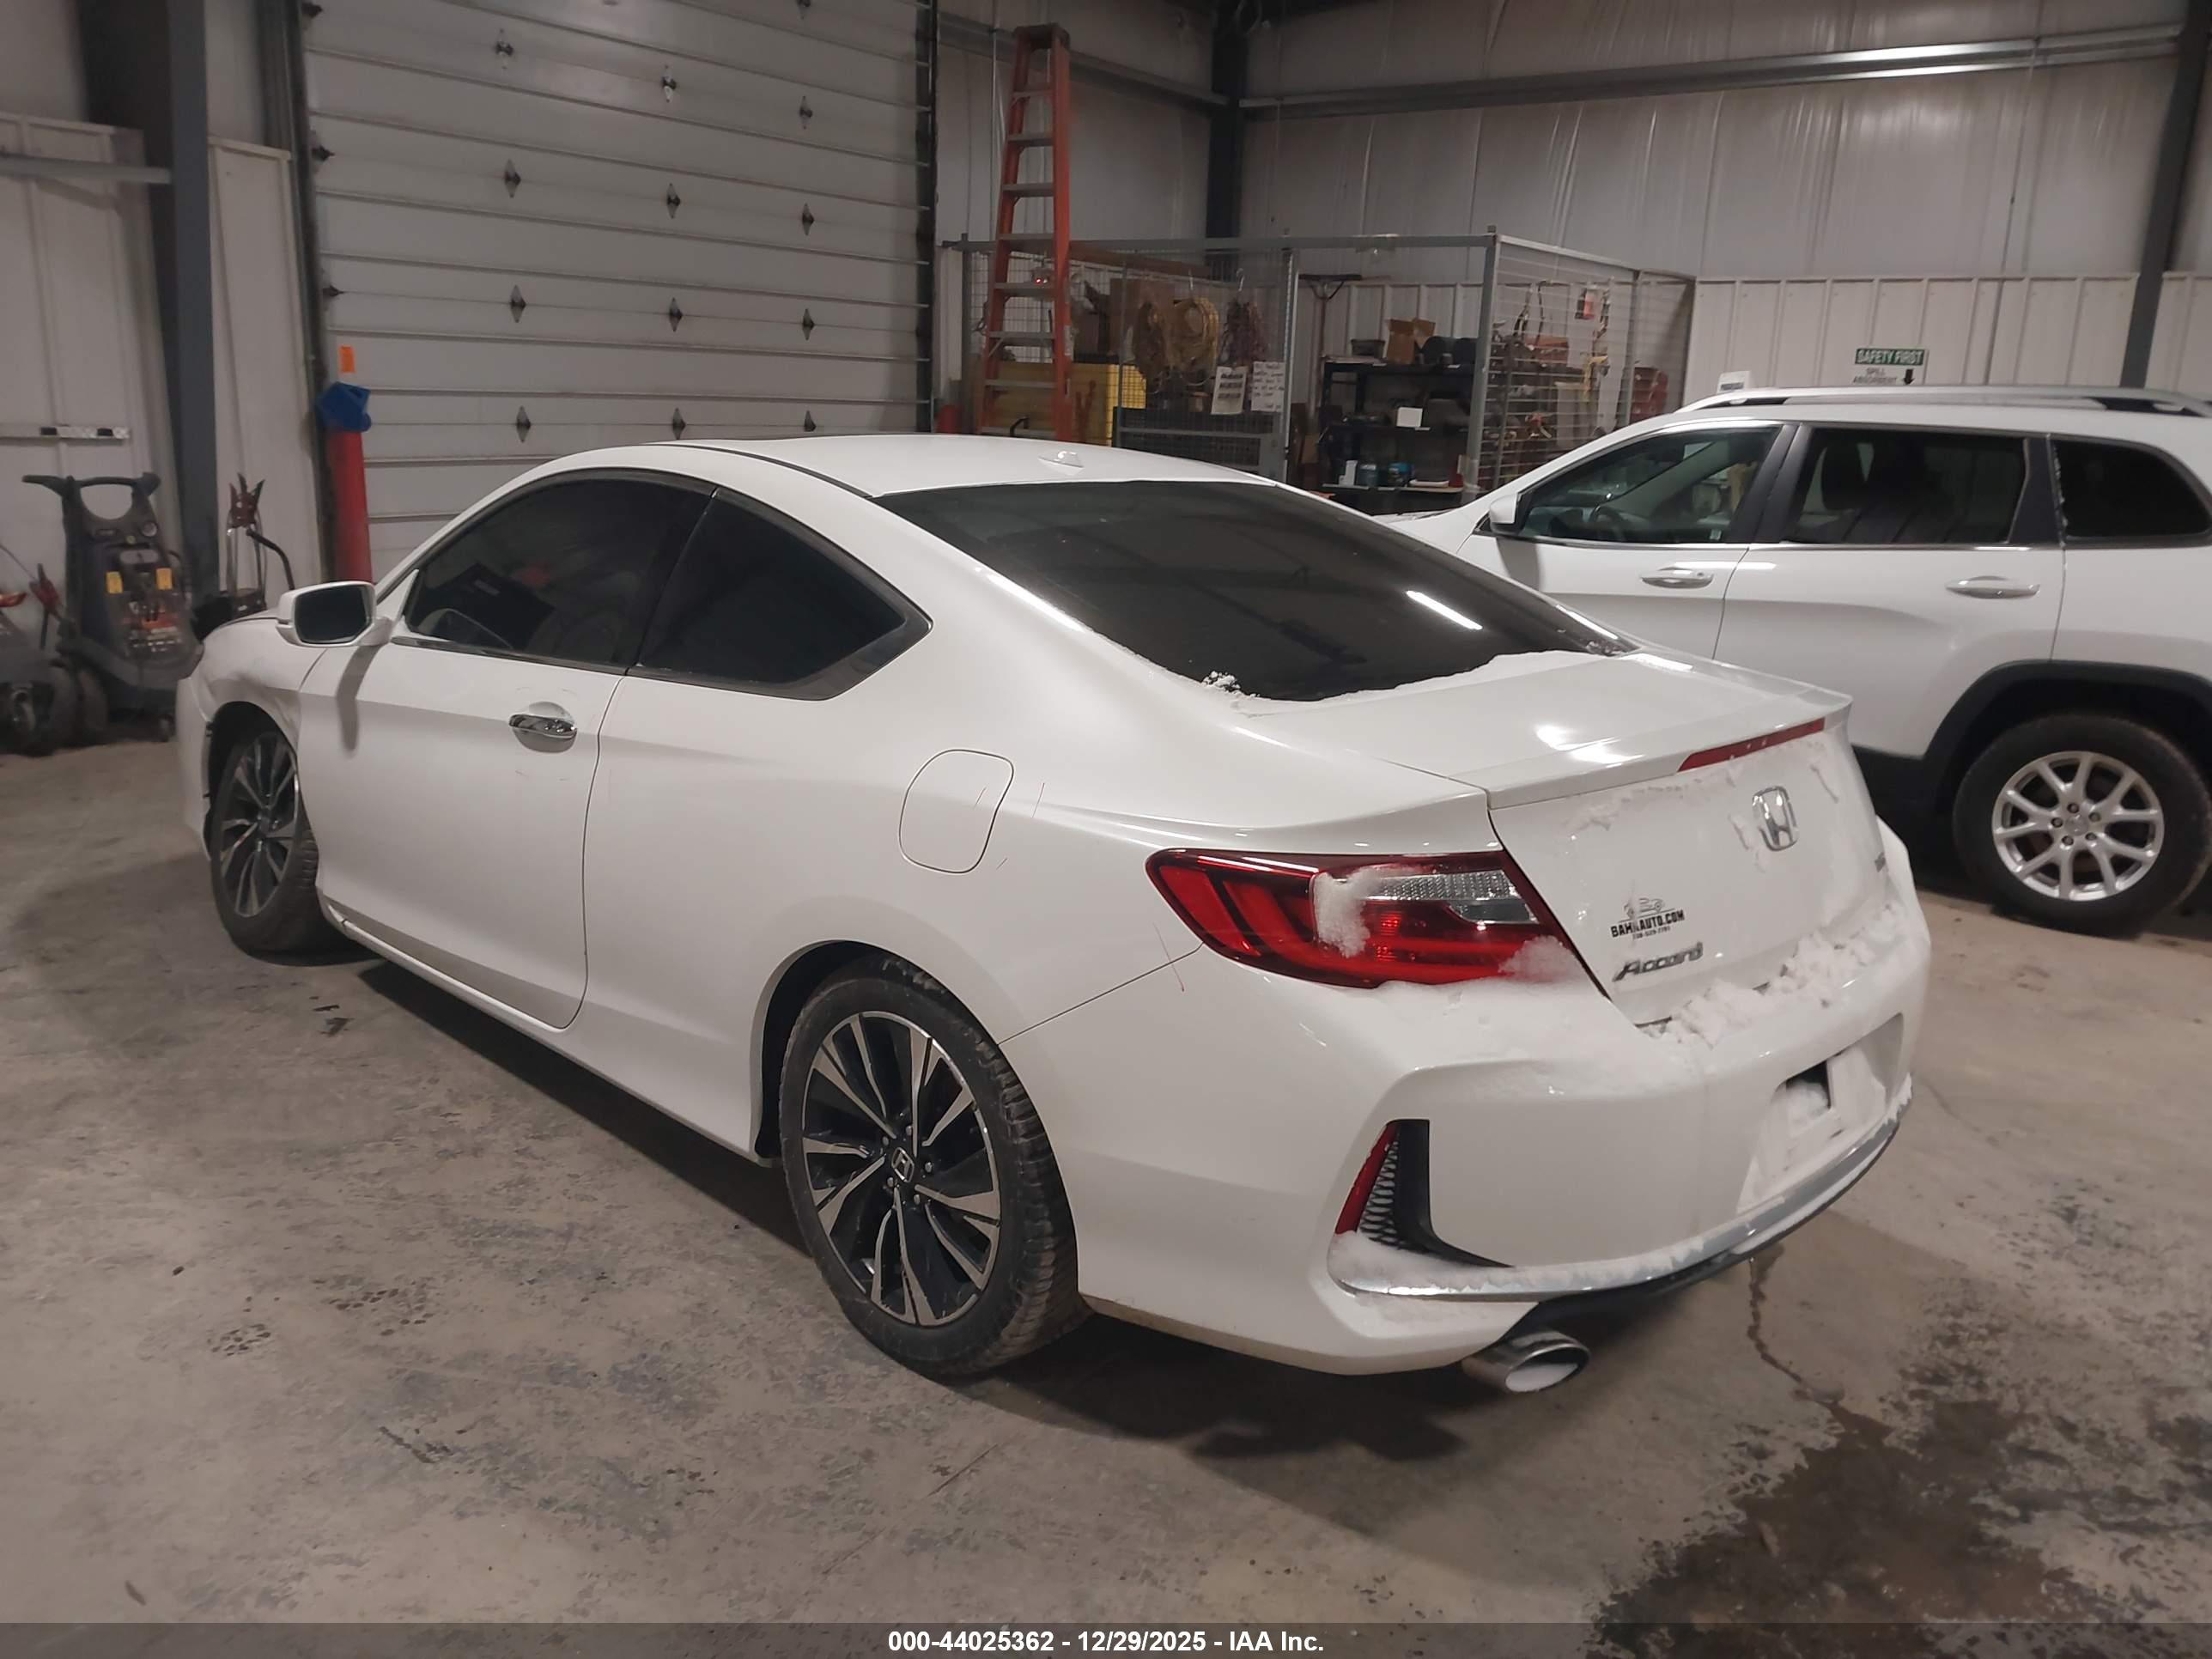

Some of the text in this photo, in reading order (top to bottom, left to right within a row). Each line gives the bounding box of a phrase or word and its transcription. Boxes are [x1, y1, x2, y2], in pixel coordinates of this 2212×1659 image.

[1857, 349, 1923, 364] SAFETY FIRST
[1612, 941, 1704, 982] Accord
